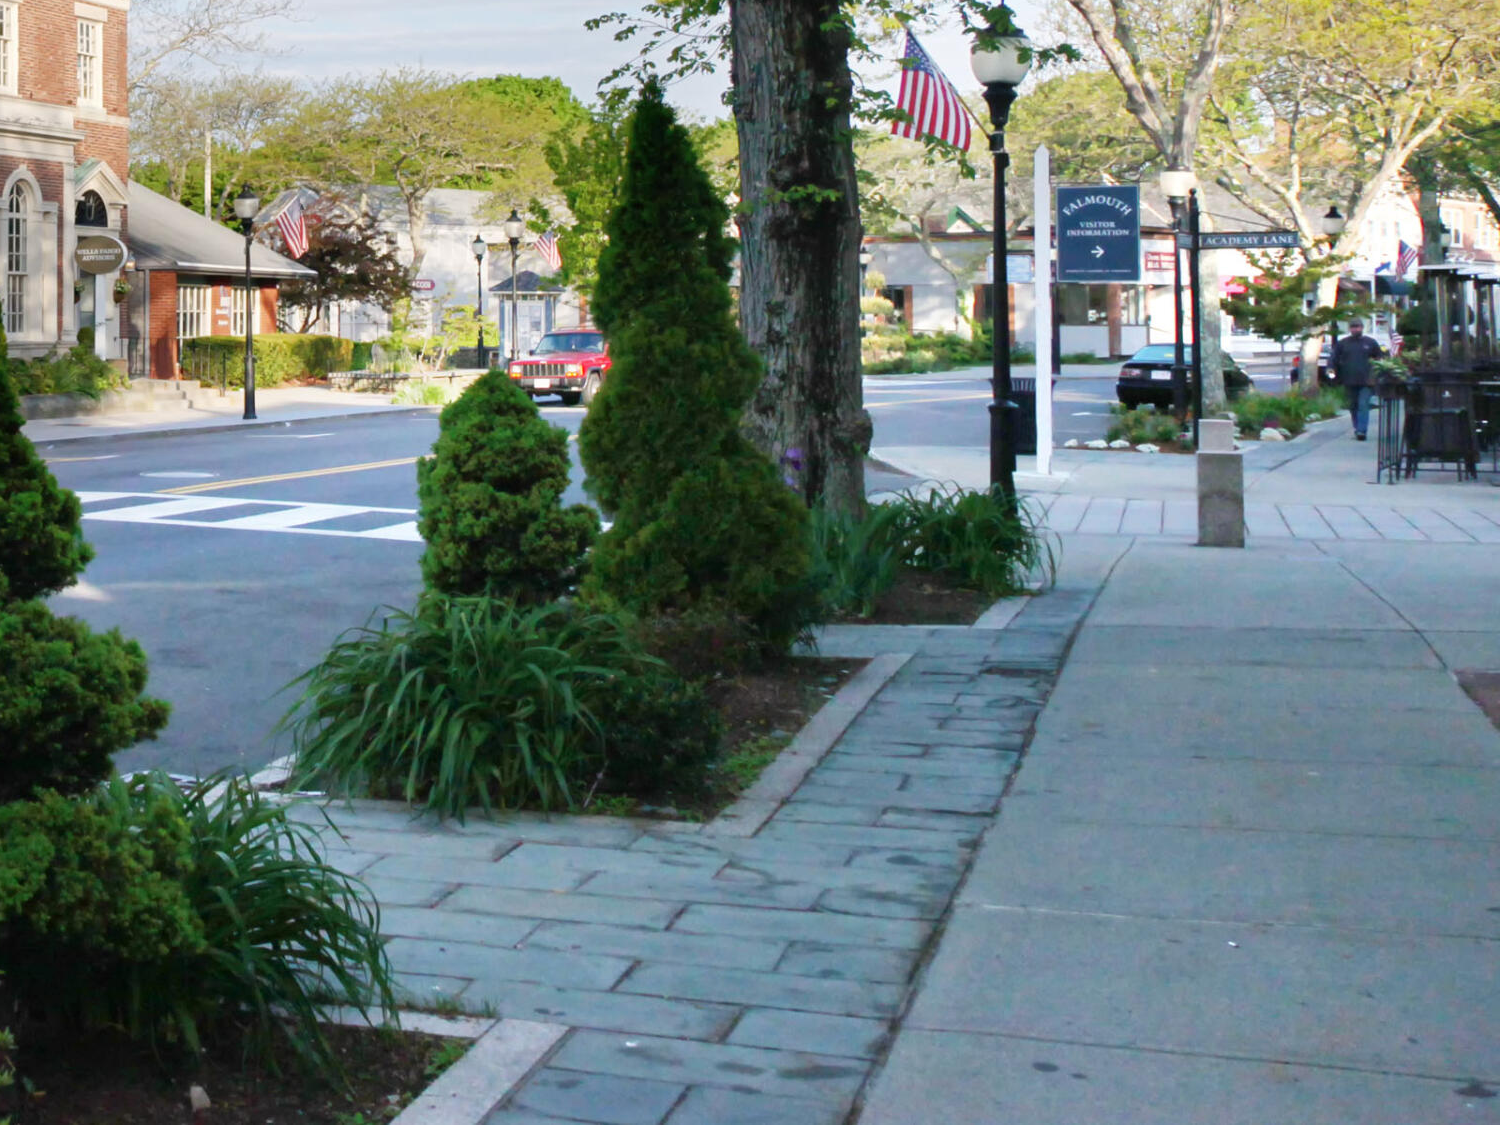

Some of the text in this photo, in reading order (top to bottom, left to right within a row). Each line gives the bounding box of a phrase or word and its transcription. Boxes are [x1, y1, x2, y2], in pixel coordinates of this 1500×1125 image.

[1062, 195, 1133, 216] FALMOUTH
[1066, 229, 1130, 237] INFORMATION
[1205, 235, 1294, 246] ACADEMY LANE
